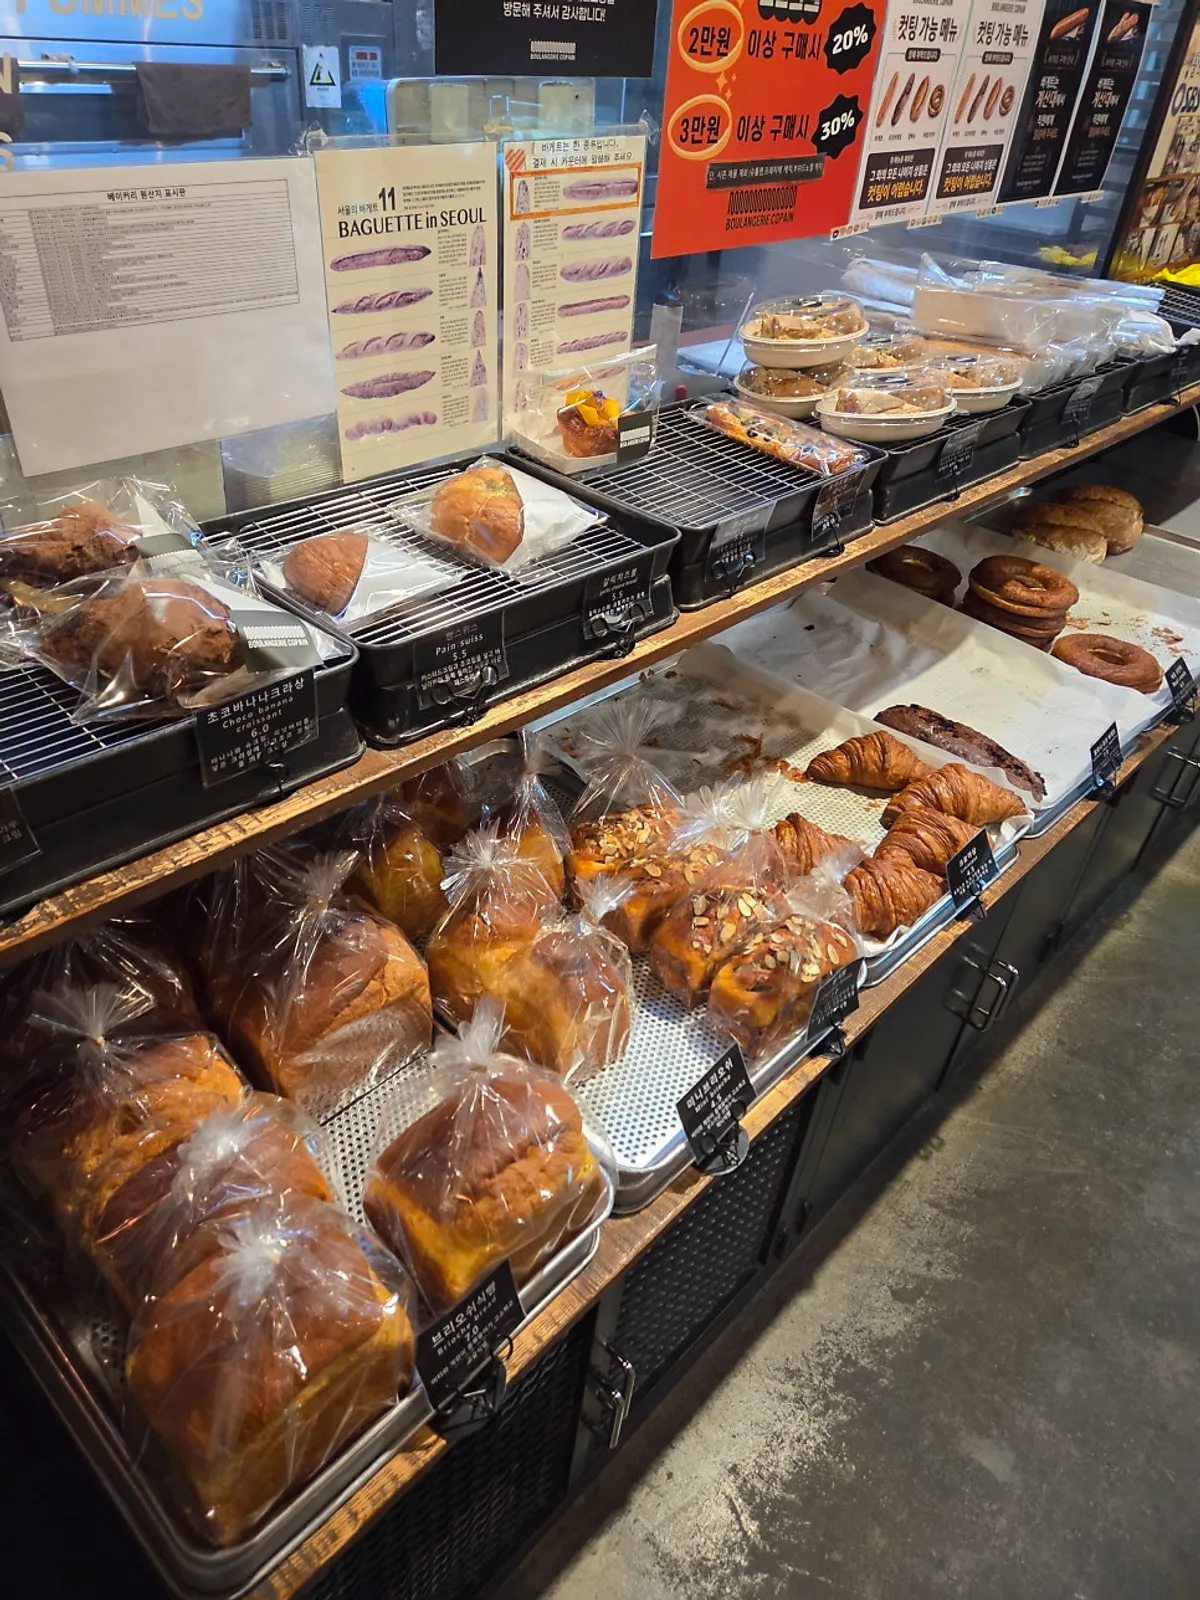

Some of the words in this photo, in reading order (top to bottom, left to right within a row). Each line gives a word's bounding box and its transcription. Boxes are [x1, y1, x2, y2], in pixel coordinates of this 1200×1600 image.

[503, 1, 531, 18] 방문해
[533, 3, 559, 19] 주셔서
[561, 5, 606, 22] 감사합니다!
[898, 14, 920, 41] 컷팅
[919, 16, 938, 42] 가능
[940, 17, 957, 42] 메뉴
[976, 20, 995, 45] 컷팅
[995, 22, 1012, 46] 가능
[1012, 23, 1029, 46] 메뉴
[688, 25, 731, 57] 2만원
[747, 29, 777, 59] 이상
[781, 31, 821, 60] 구매시
[832, 24, 868, 54] 20%
[679, 115, 721, 144] 3만원
[736, 115, 765, 142] 이상
[770, 114, 809, 141] 구매시
[820, 109, 855, 141] 30%
[541, 141, 569, 152] 바게트는
[573, 140, 580, 152] 한
[533, 157, 547, 169] 결제
[551, 157, 558, 167] 시
[561, 155, 588, 167] 카운터에
[107, 190, 138, 202] 베이커리
[140, 188, 163, 200] 원산지
[165, 187, 187, 198] 표시판
[338, 203, 358, 216] 서울의
[359, 202, 379, 214] 바게트
[378, 186, 397, 212] 11
[867, 182, 891, 203] 컷팅이
[338, 213, 423, 239] BAGUETTE
[426, 211, 438, 229] in
[440, 207, 487, 228] SEOUL
[725, 215, 769, 231] BOULANGERIE
[770, 211, 794, 224] COPAIN
[248, 639, 288, 649] BOULANGERIE
[436, 643, 456, 656] Pain
[452, 649, 467, 661] 5.5
[206, 677, 305, 725] 초코바나나크라상
[222, 712, 254, 729] Choco
[258, 696, 294, 715] banana
[236, 709, 283, 733] croissant
[250, 723, 270, 738] 6.0
[686, 1057, 734, 1109] 미니브리오쉬
[431, 1280, 497, 1348] 브리오쉬식빵
[437, 1322, 471, 1356] Brioche
[464, 1325, 480, 1342] 7.0
